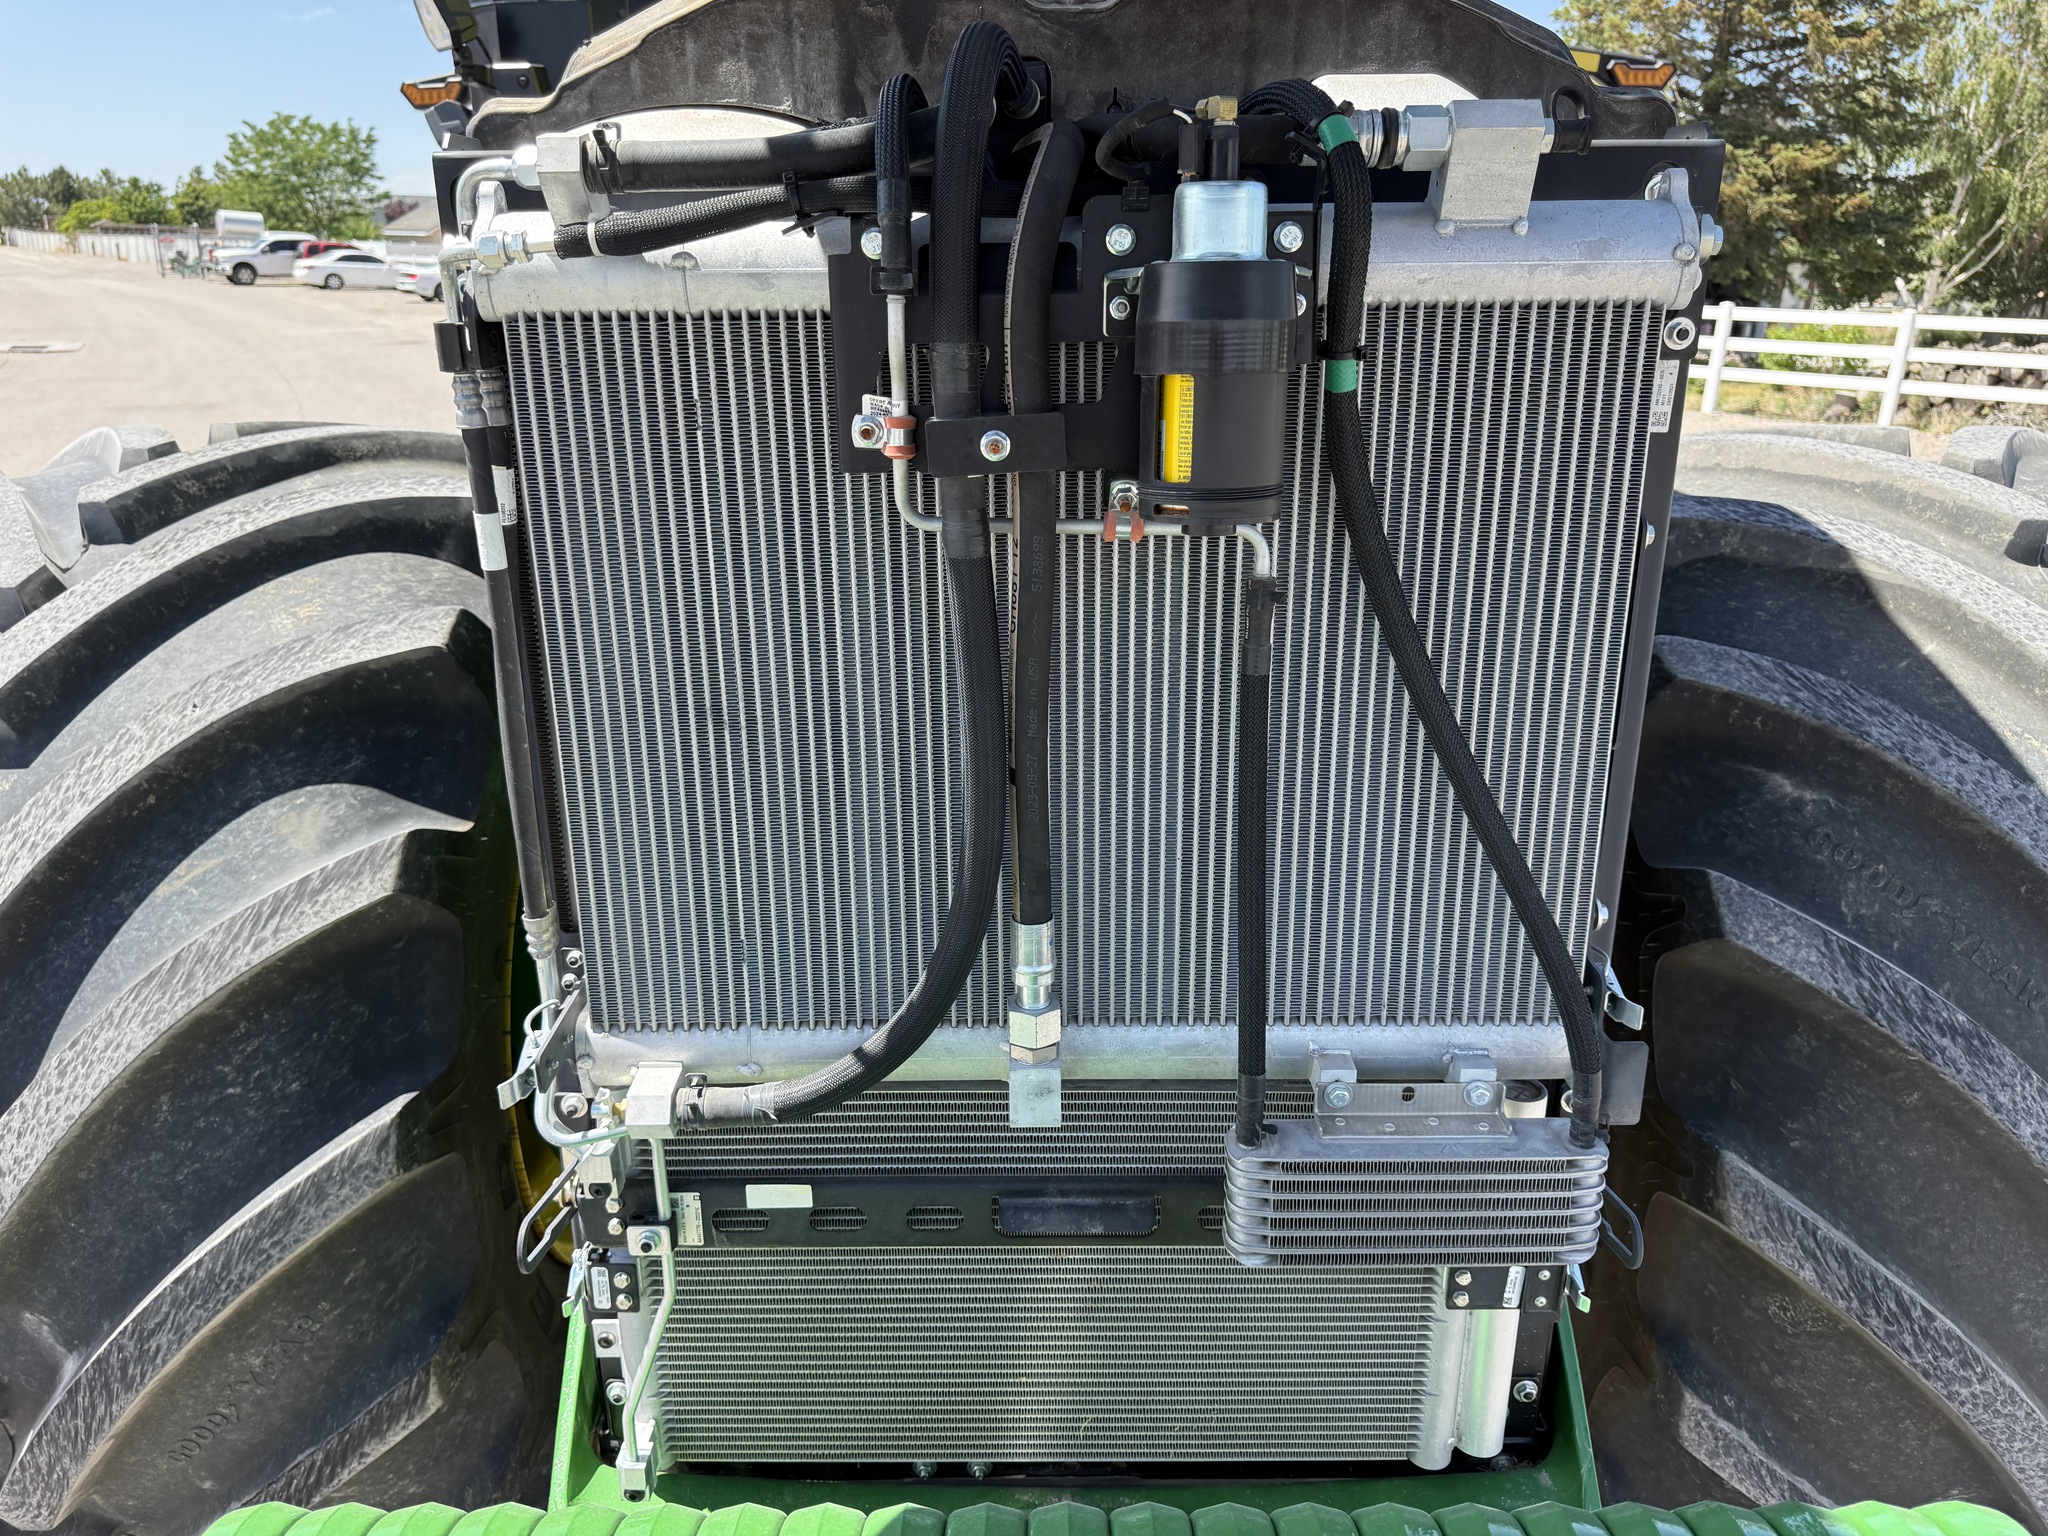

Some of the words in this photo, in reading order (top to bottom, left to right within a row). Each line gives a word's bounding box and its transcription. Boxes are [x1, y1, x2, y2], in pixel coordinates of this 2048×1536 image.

[1031, 535, 1044, 592] 5138699
[1028, 657, 1039, 680] USA
[1028, 687, 1038, 701] in
[1027, 708, 1038, 738] Made
